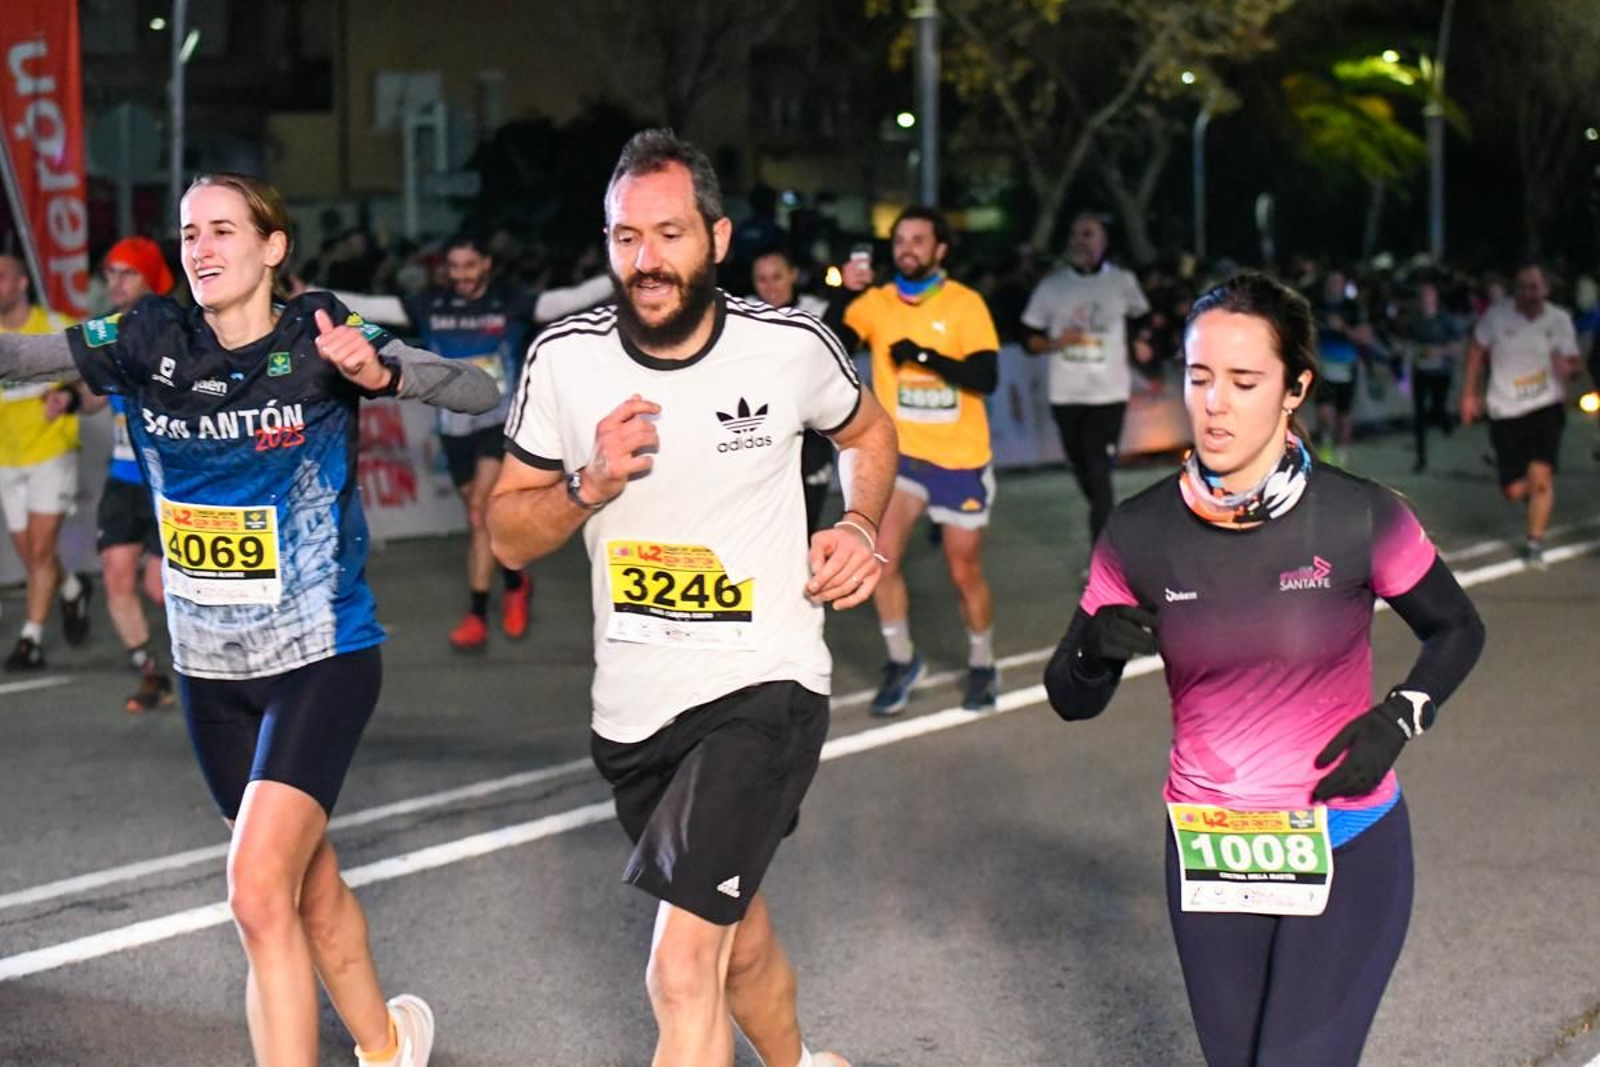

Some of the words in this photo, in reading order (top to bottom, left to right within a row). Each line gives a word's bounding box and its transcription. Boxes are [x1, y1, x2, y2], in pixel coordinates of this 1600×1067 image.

[142, 408, 191, 439] SAN
[197, 400, 304, 440] ANTÓN
[255, 424, 305, 451] 2025
[717, 435, 773, 453] adidas
[169, 531, 265, 568] 4069
[637, 545, 662, 562] 42
[622, 567, 742, 609] 3246
[1279, 577, 1316, 592] SANTA
[1317, 577, 1331, 589] FE
[1202, 811, 1230, 828] 42
[1190, 833, 1319, 872] 1008
